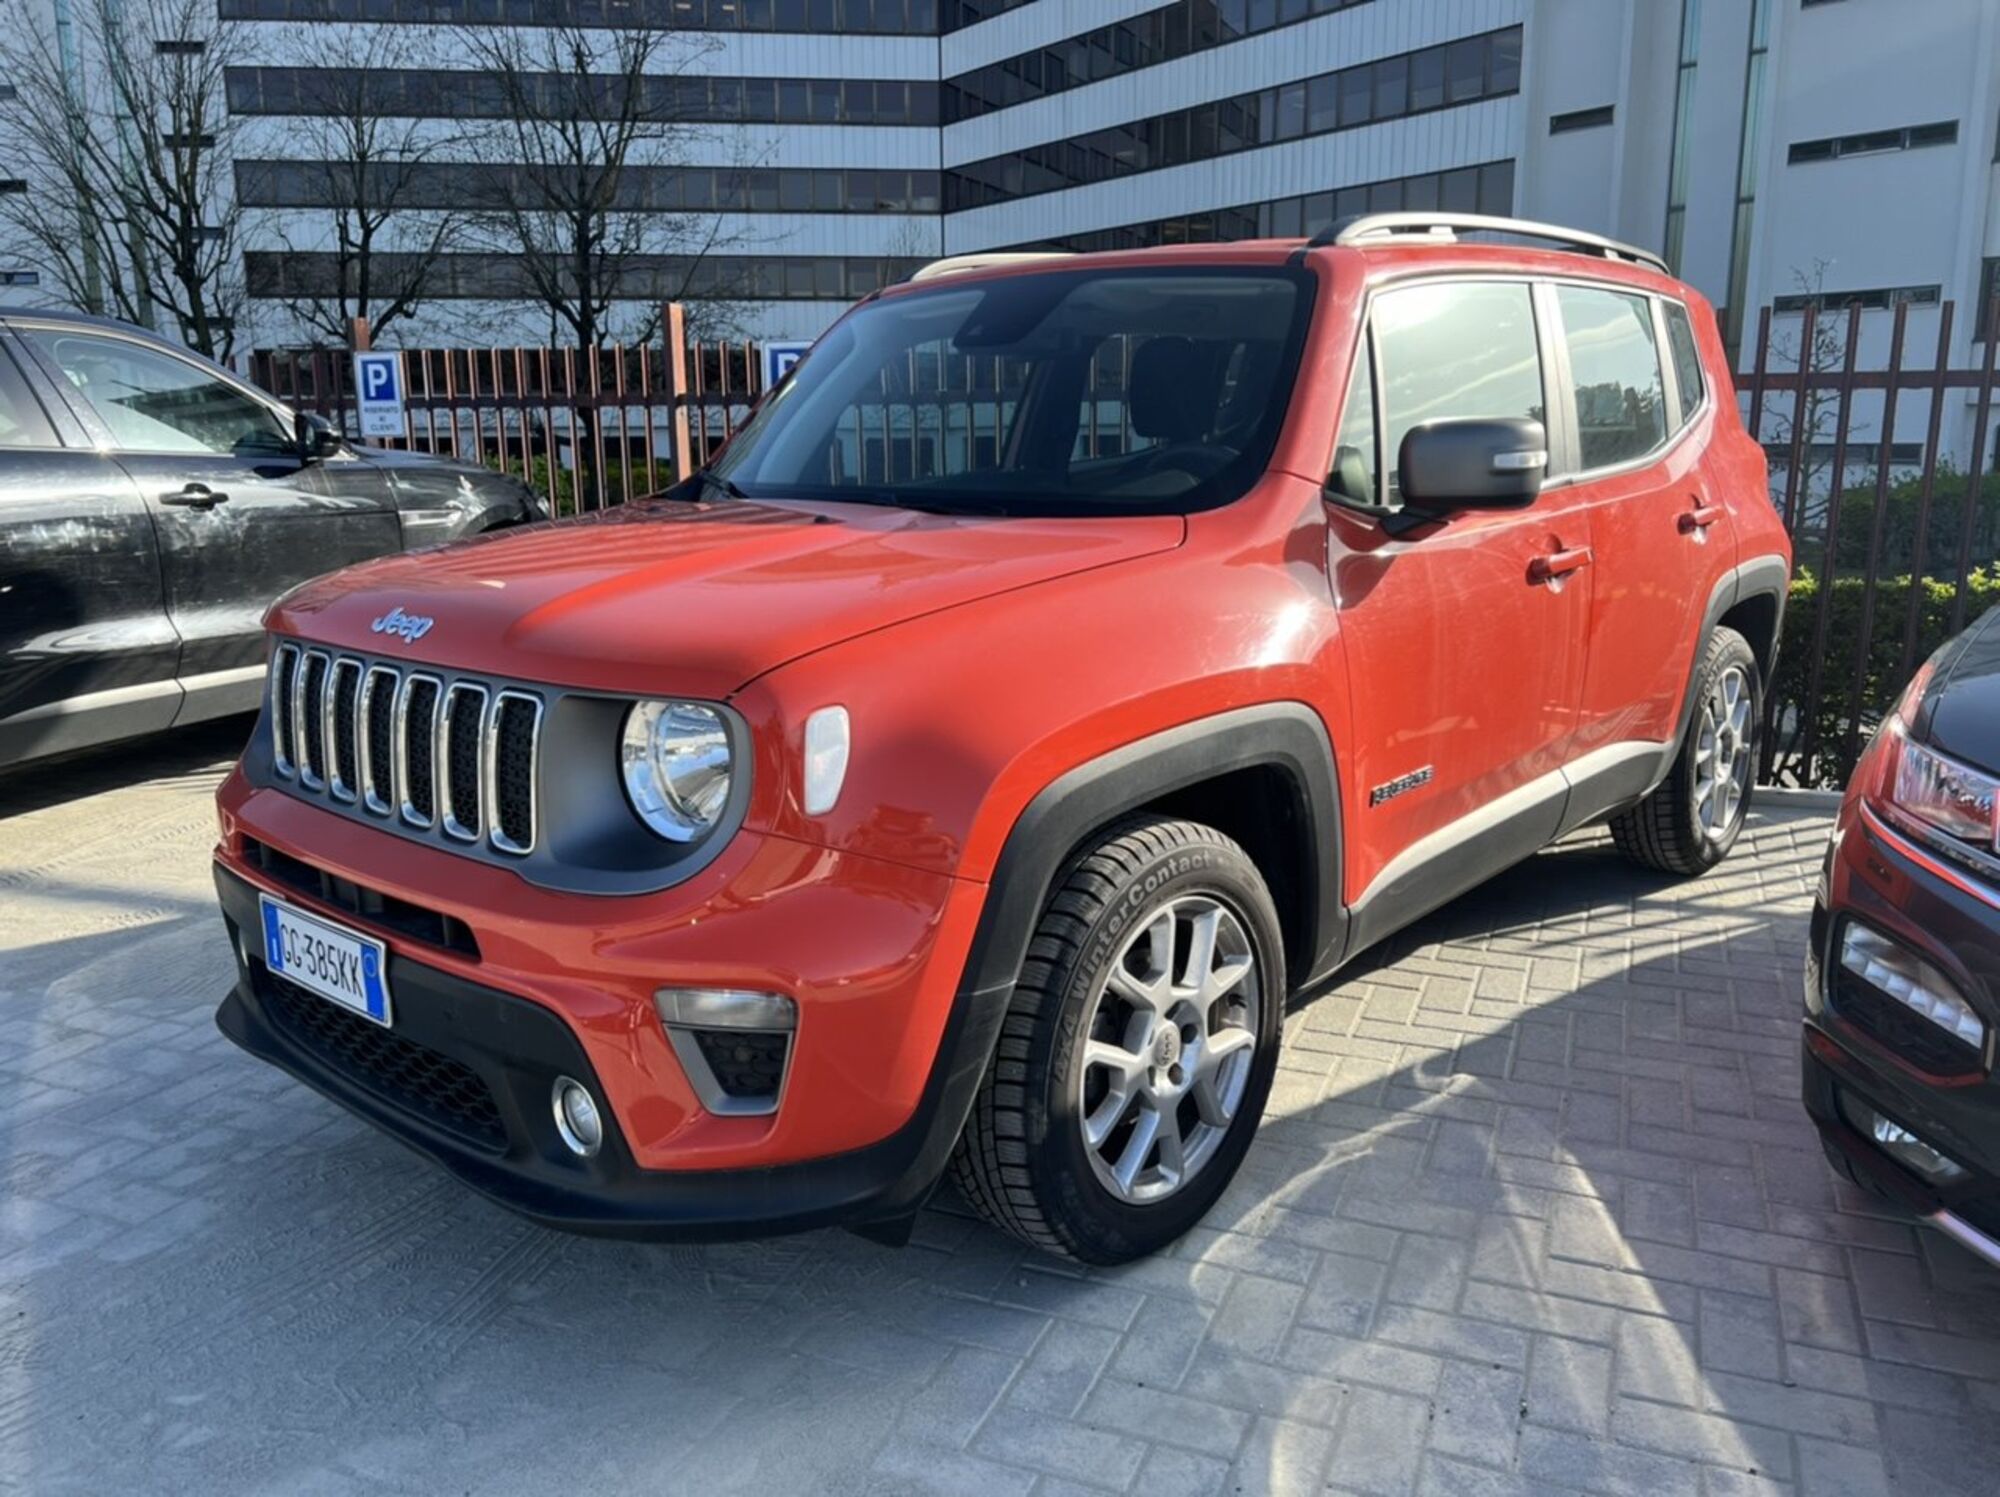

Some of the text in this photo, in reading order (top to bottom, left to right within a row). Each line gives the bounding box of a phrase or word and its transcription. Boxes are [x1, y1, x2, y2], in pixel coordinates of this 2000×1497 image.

[367, 363, 388, 398] P
[371, 607, 434, 645] Jeep
[1070, 850, 1212, 1000] WinterContact
